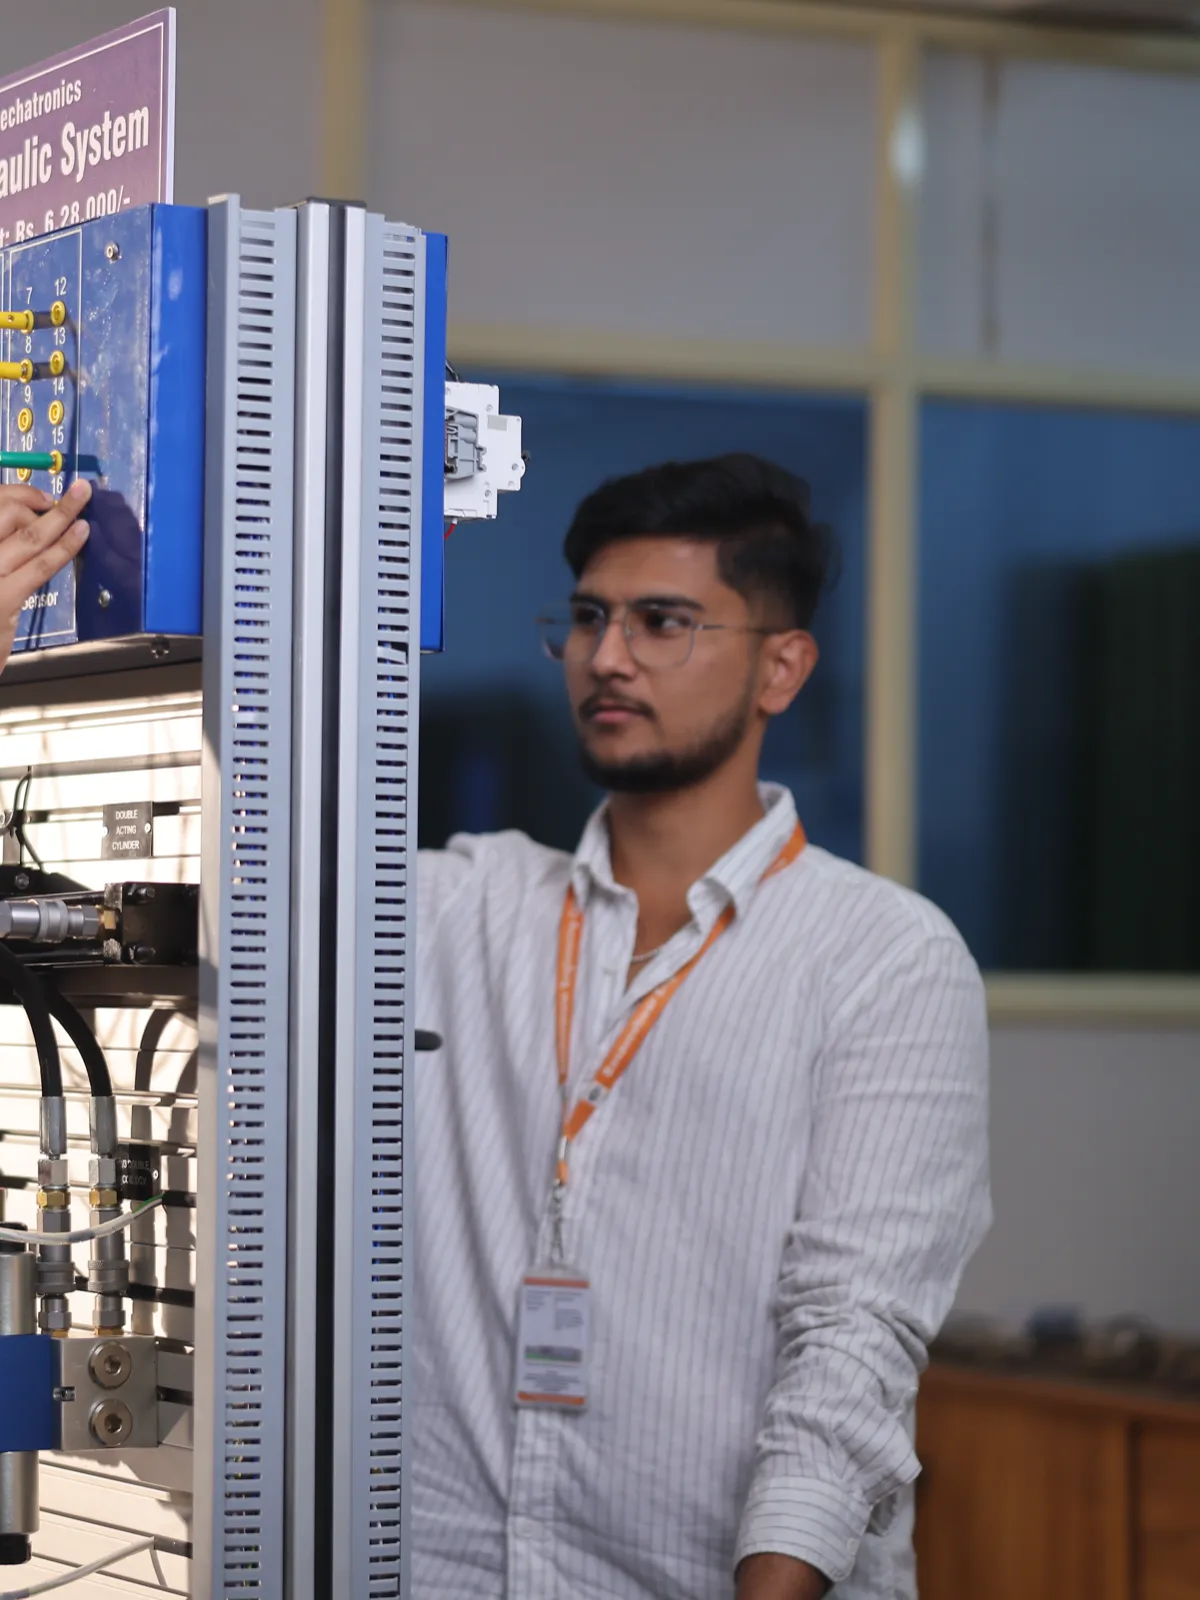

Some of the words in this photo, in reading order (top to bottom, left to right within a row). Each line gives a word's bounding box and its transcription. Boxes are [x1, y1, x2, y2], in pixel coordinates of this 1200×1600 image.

[60, 106, 149, 184] System
[26, 287, 33, 305] 7
[54, 276, 67, 297] 12
[25, 335, 32, 354] 8
[53, 326, 66, 346] 13
[24, 385, 31, 403] 9
[52, 376, 65, 395] 14
[21, 433, 33, 452] 10
[52, 426, 64, 446] 15
[50, 476, 63, 495] 16
[115, 809, 138, 820] DOUBLE
[116, 825, 137, 835] ACTING
[112, 840, 140, 851] CYLINDER
